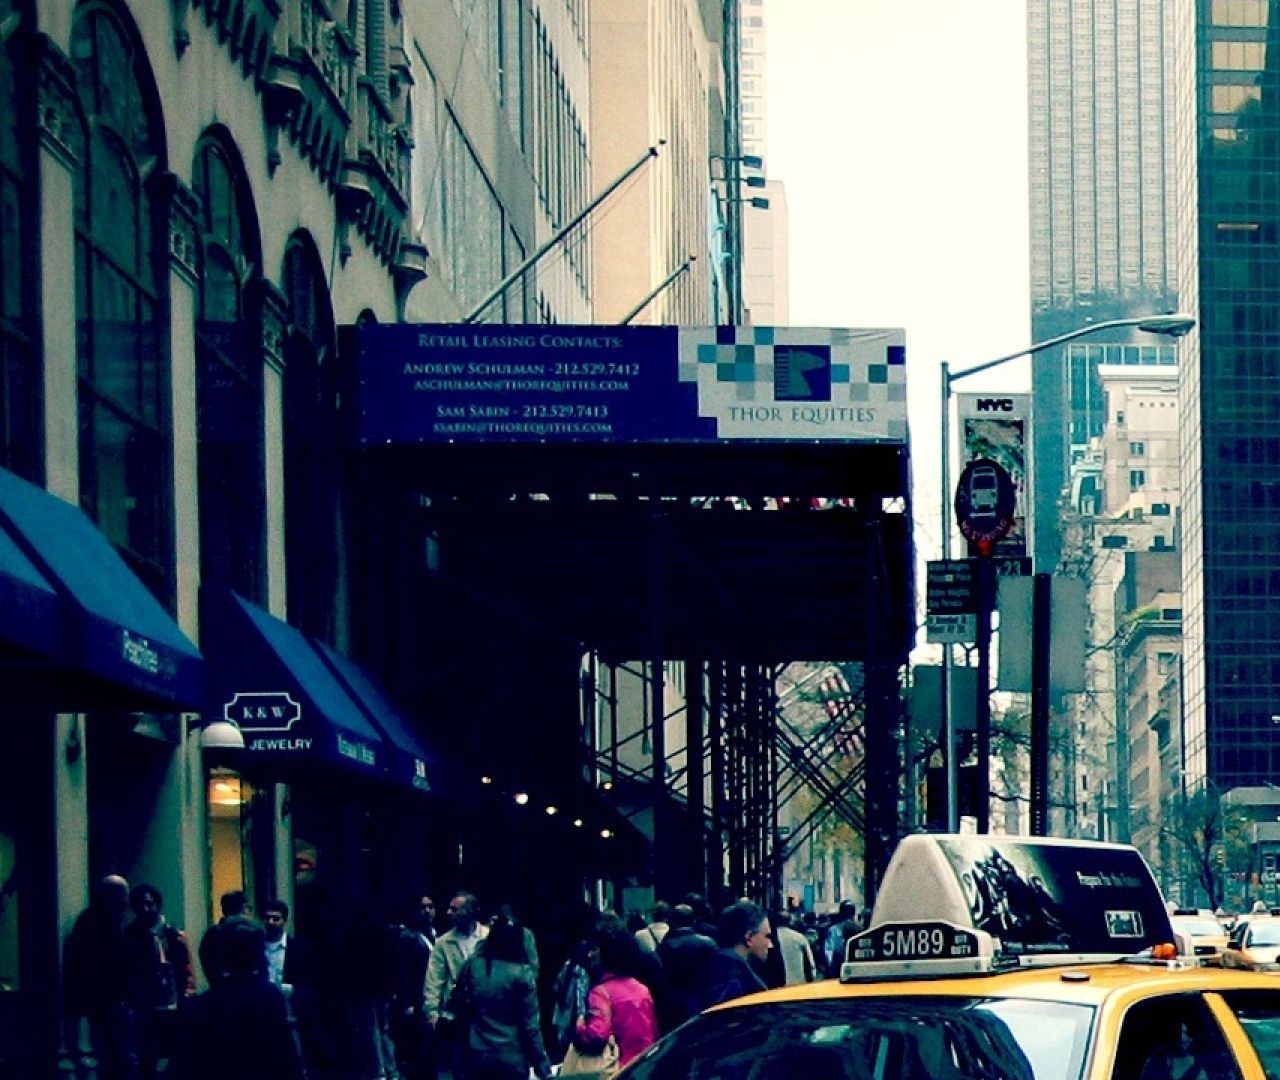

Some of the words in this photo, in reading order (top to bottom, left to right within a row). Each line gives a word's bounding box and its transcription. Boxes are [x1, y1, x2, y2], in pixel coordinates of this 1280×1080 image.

[977, 398, 1013, 412] NYC
[729, 407, 783, 422] THOR
[791, 407, 877, 425] EQUITIES
[243, 706, 253, 719] K
[257, 706, 268, 719] &
[271, 706, 286, 719] W
[249, 738, 313, 751] JEWELRY
[882, 929, 944, 958] 5M89
